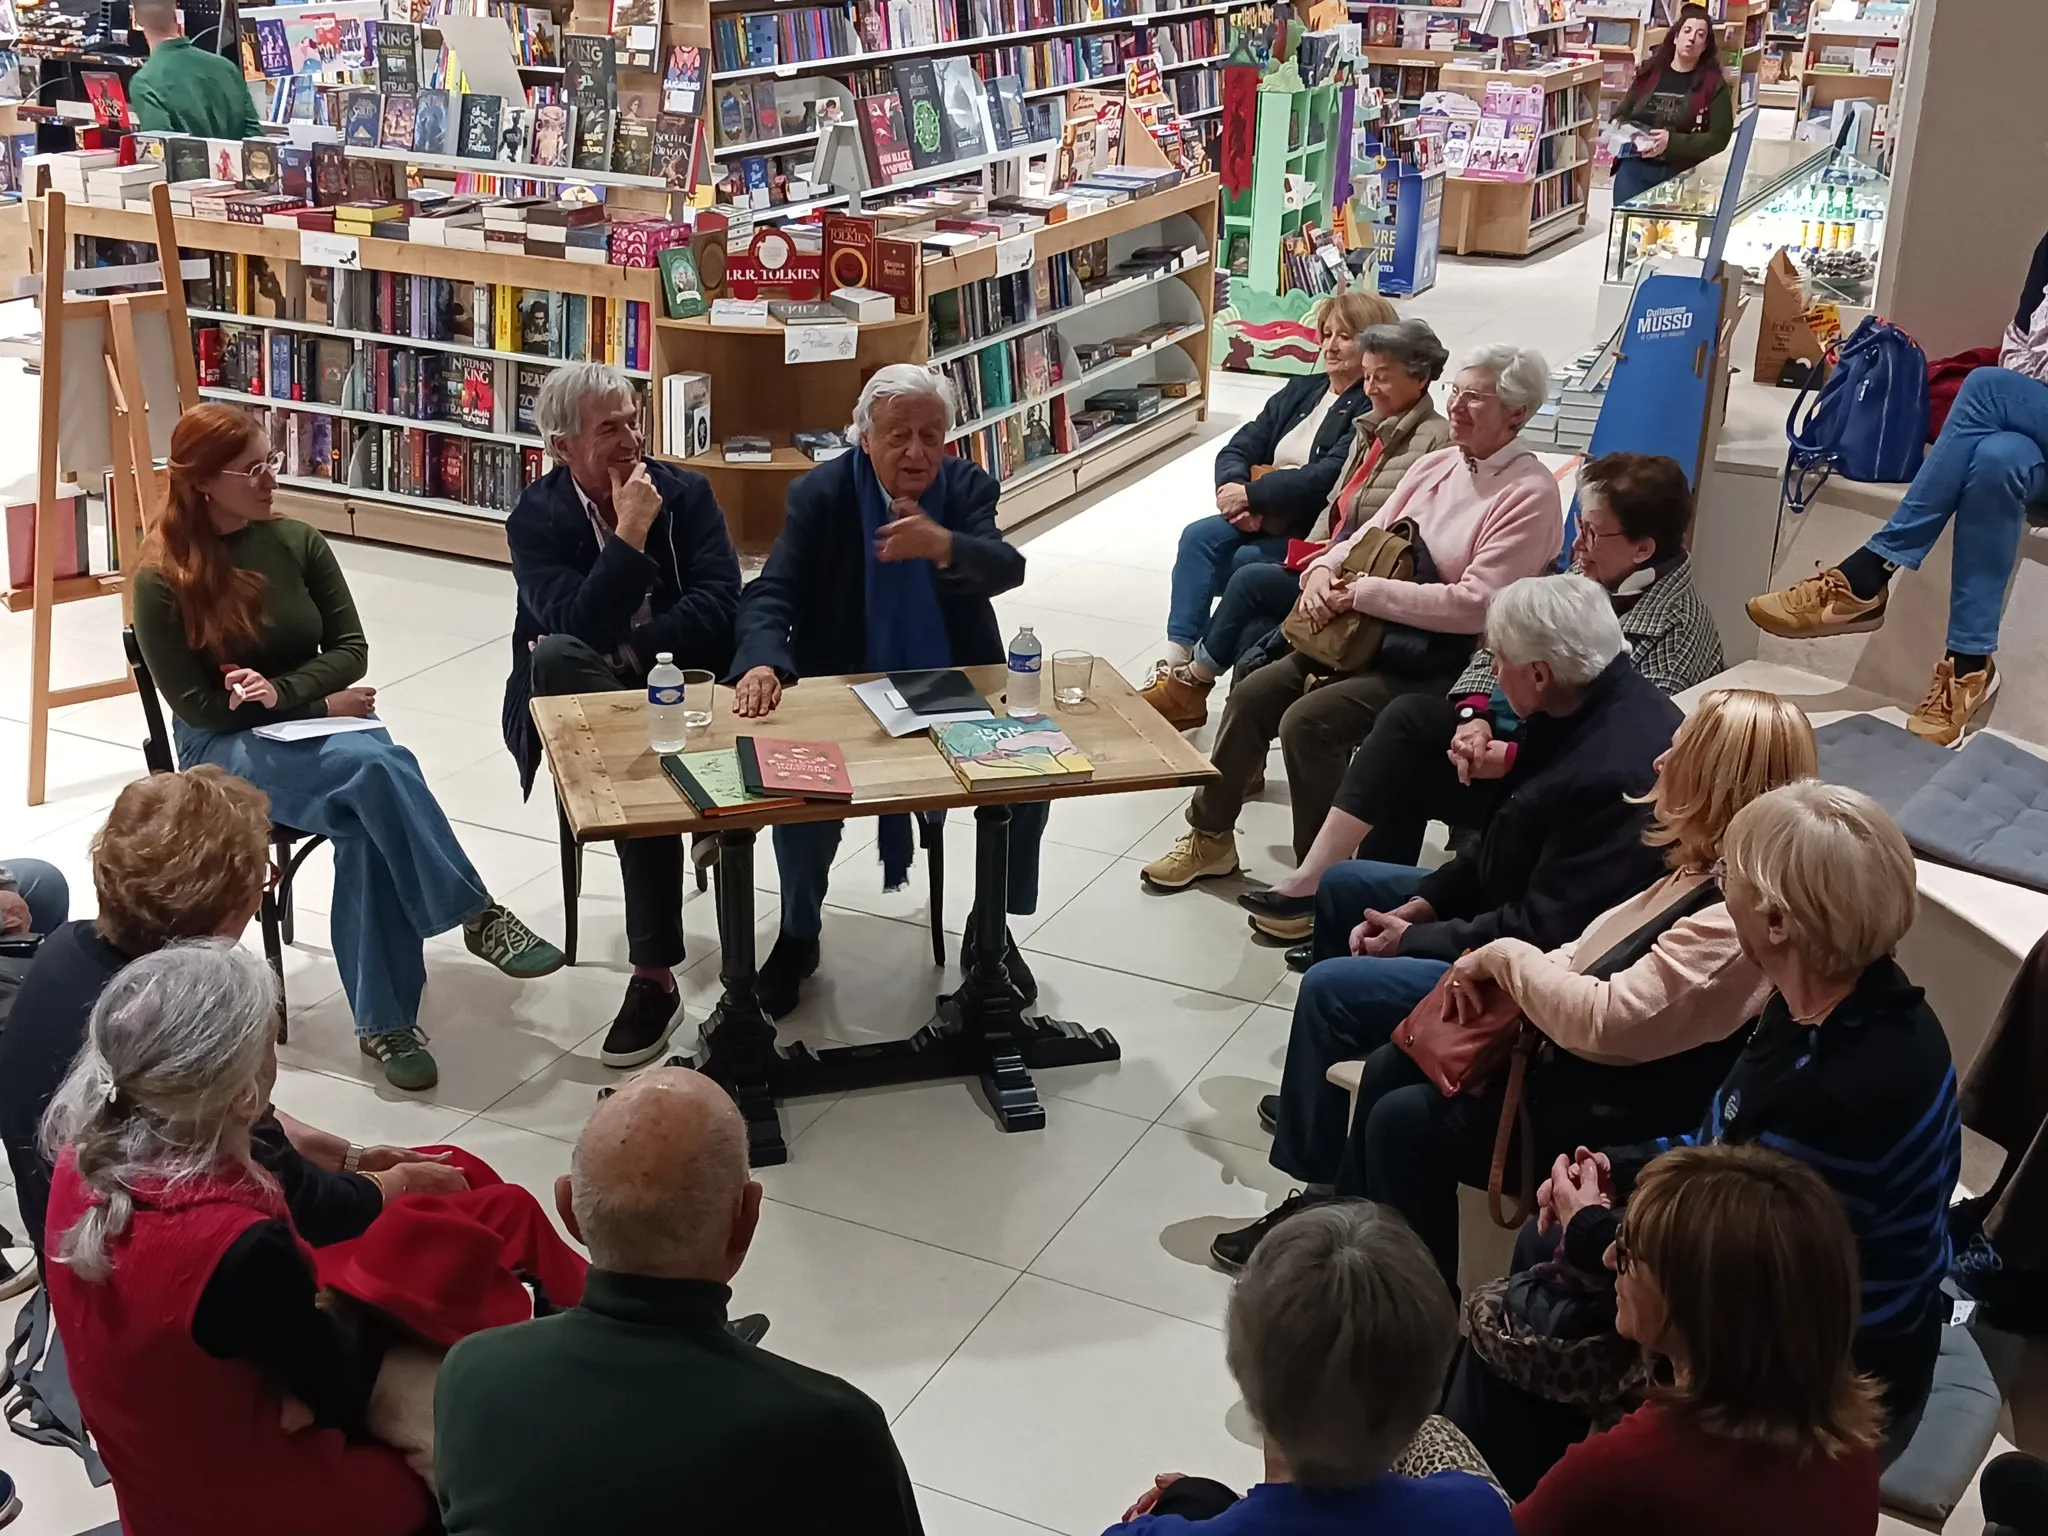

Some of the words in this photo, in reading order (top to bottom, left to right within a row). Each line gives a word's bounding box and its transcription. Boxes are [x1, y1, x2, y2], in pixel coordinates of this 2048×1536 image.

[378, 30, 413, 47] KING
[568, 44, 604, 62] KING
[98, 104, 124, 118] KING
[829, 227, 871, 243] TOLKIEN
[760, 268, 820, 280] TOLKIEN
[1637, 312, 1693, 334] MUSSO
[1772, 321, 1795, 333] folio
[462, 357, 493, 372] STEPHEN
[464, 367, 489, 384] KING
[519, 393, 537, 408] ZO
